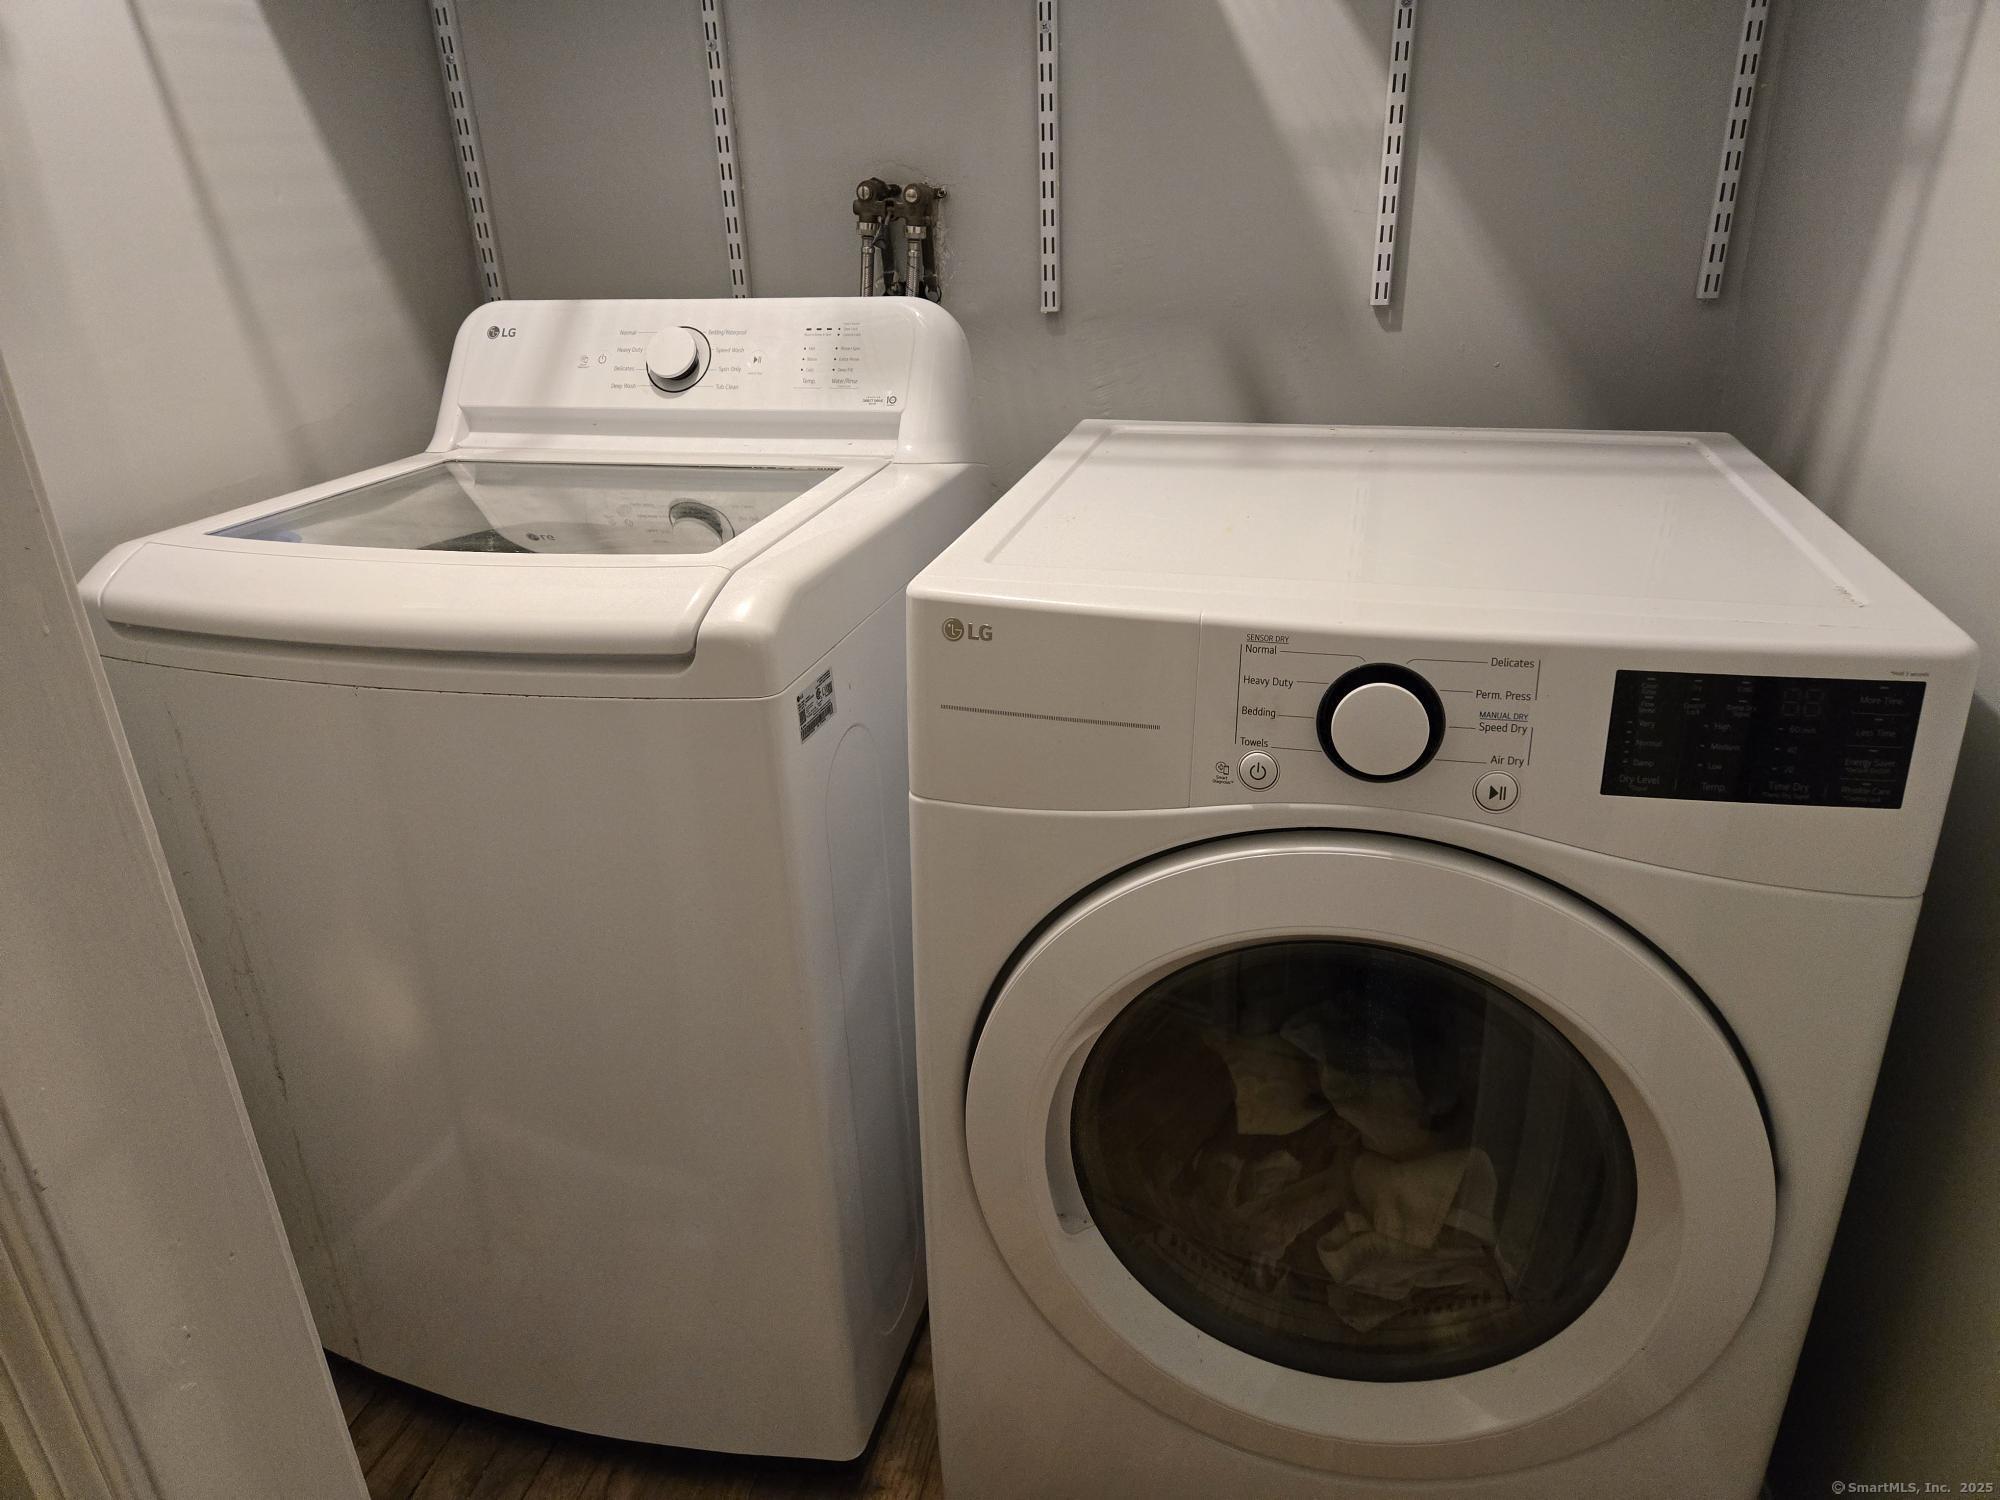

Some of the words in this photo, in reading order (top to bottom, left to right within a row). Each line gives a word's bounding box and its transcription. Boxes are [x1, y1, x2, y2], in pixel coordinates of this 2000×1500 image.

[502, 328, 516, 338] LG
[967, 622, 993, 642] LG
[1246, 633, 1274, 642] SENSOR
[1275, 635, 1289, 643] DRY
[1245, 644, 1277, 655] Normal
[1490, 657, 1535, 669] Delicates
[1243, 675, 1270, 688] Heavy
[1272, 677, 1294, 690] Duty
[1475, 690, 1502, 700] Perm.
[1505, 691, 1531, 701] Press
[1241, 706, 1276, 719] Bedding
[1479, 711, 1511, 720] MANUAL
[1479, 722, 1507, 734] Speed
[1511, 723, 1528, 736] Dry
[1240, 737, 1269, 748] Towels
[1490, 755, 1504, 765] Air
[1507, 757, 1525, 768] Dry
[1619, 775, 1635, 786] Dry
[1636, 776, 1660, 785] Level
